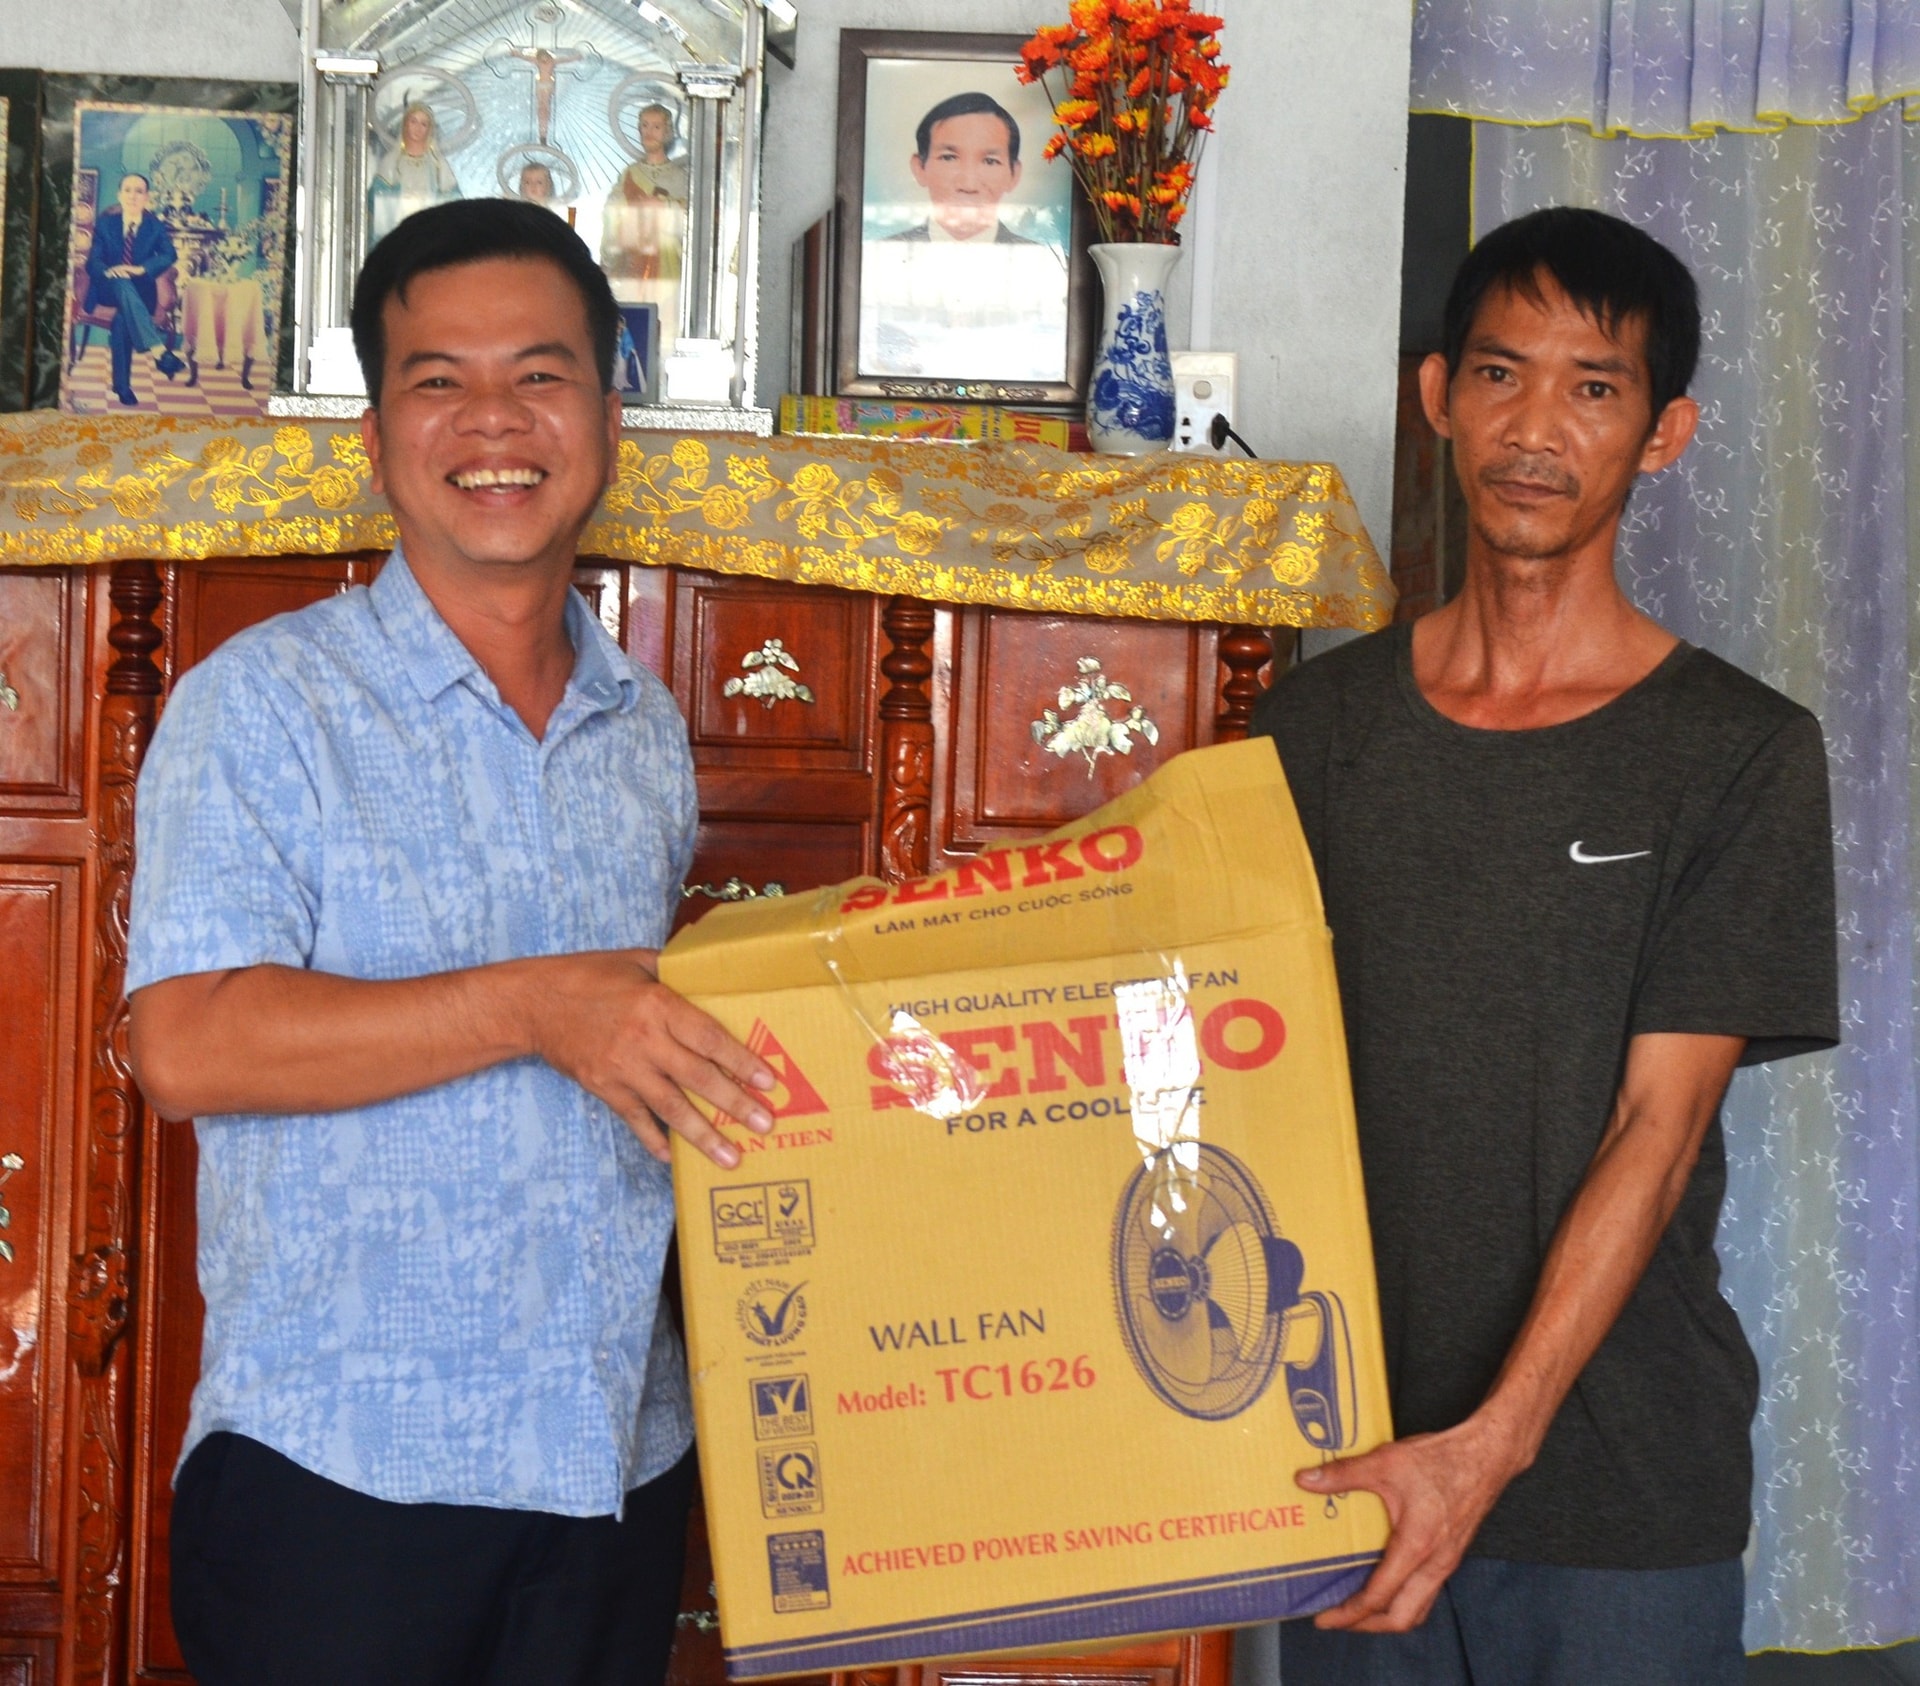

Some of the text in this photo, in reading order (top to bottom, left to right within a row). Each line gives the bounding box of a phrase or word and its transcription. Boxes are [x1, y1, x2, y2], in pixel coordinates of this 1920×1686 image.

[969, 904, 1011, 920] CHO
[889, 969, 1238, 1019] HIGH QUALITY ELEC FAN
[866, 998, 1287, 1111] SENO
[773, 1128, 833, 1150] TIEN
[946, 1111, 1008, 1135] FOR
[1017, 1108, 1037, 1127] A
[1045, 1097, 1132, 1123] COOL
[868, 1307, 1046, 1352] WALL FAN
[837, 1354, 1096, 1415] Model: TC1626
[841, 1541, 966, 1576] ACHIEVED
[973, 1531, 1059, 1563] POWER
[1064, 1521, 1152, 1553] SAVING
[1159, 1504, 1306, 1541] CERTIFICATE
